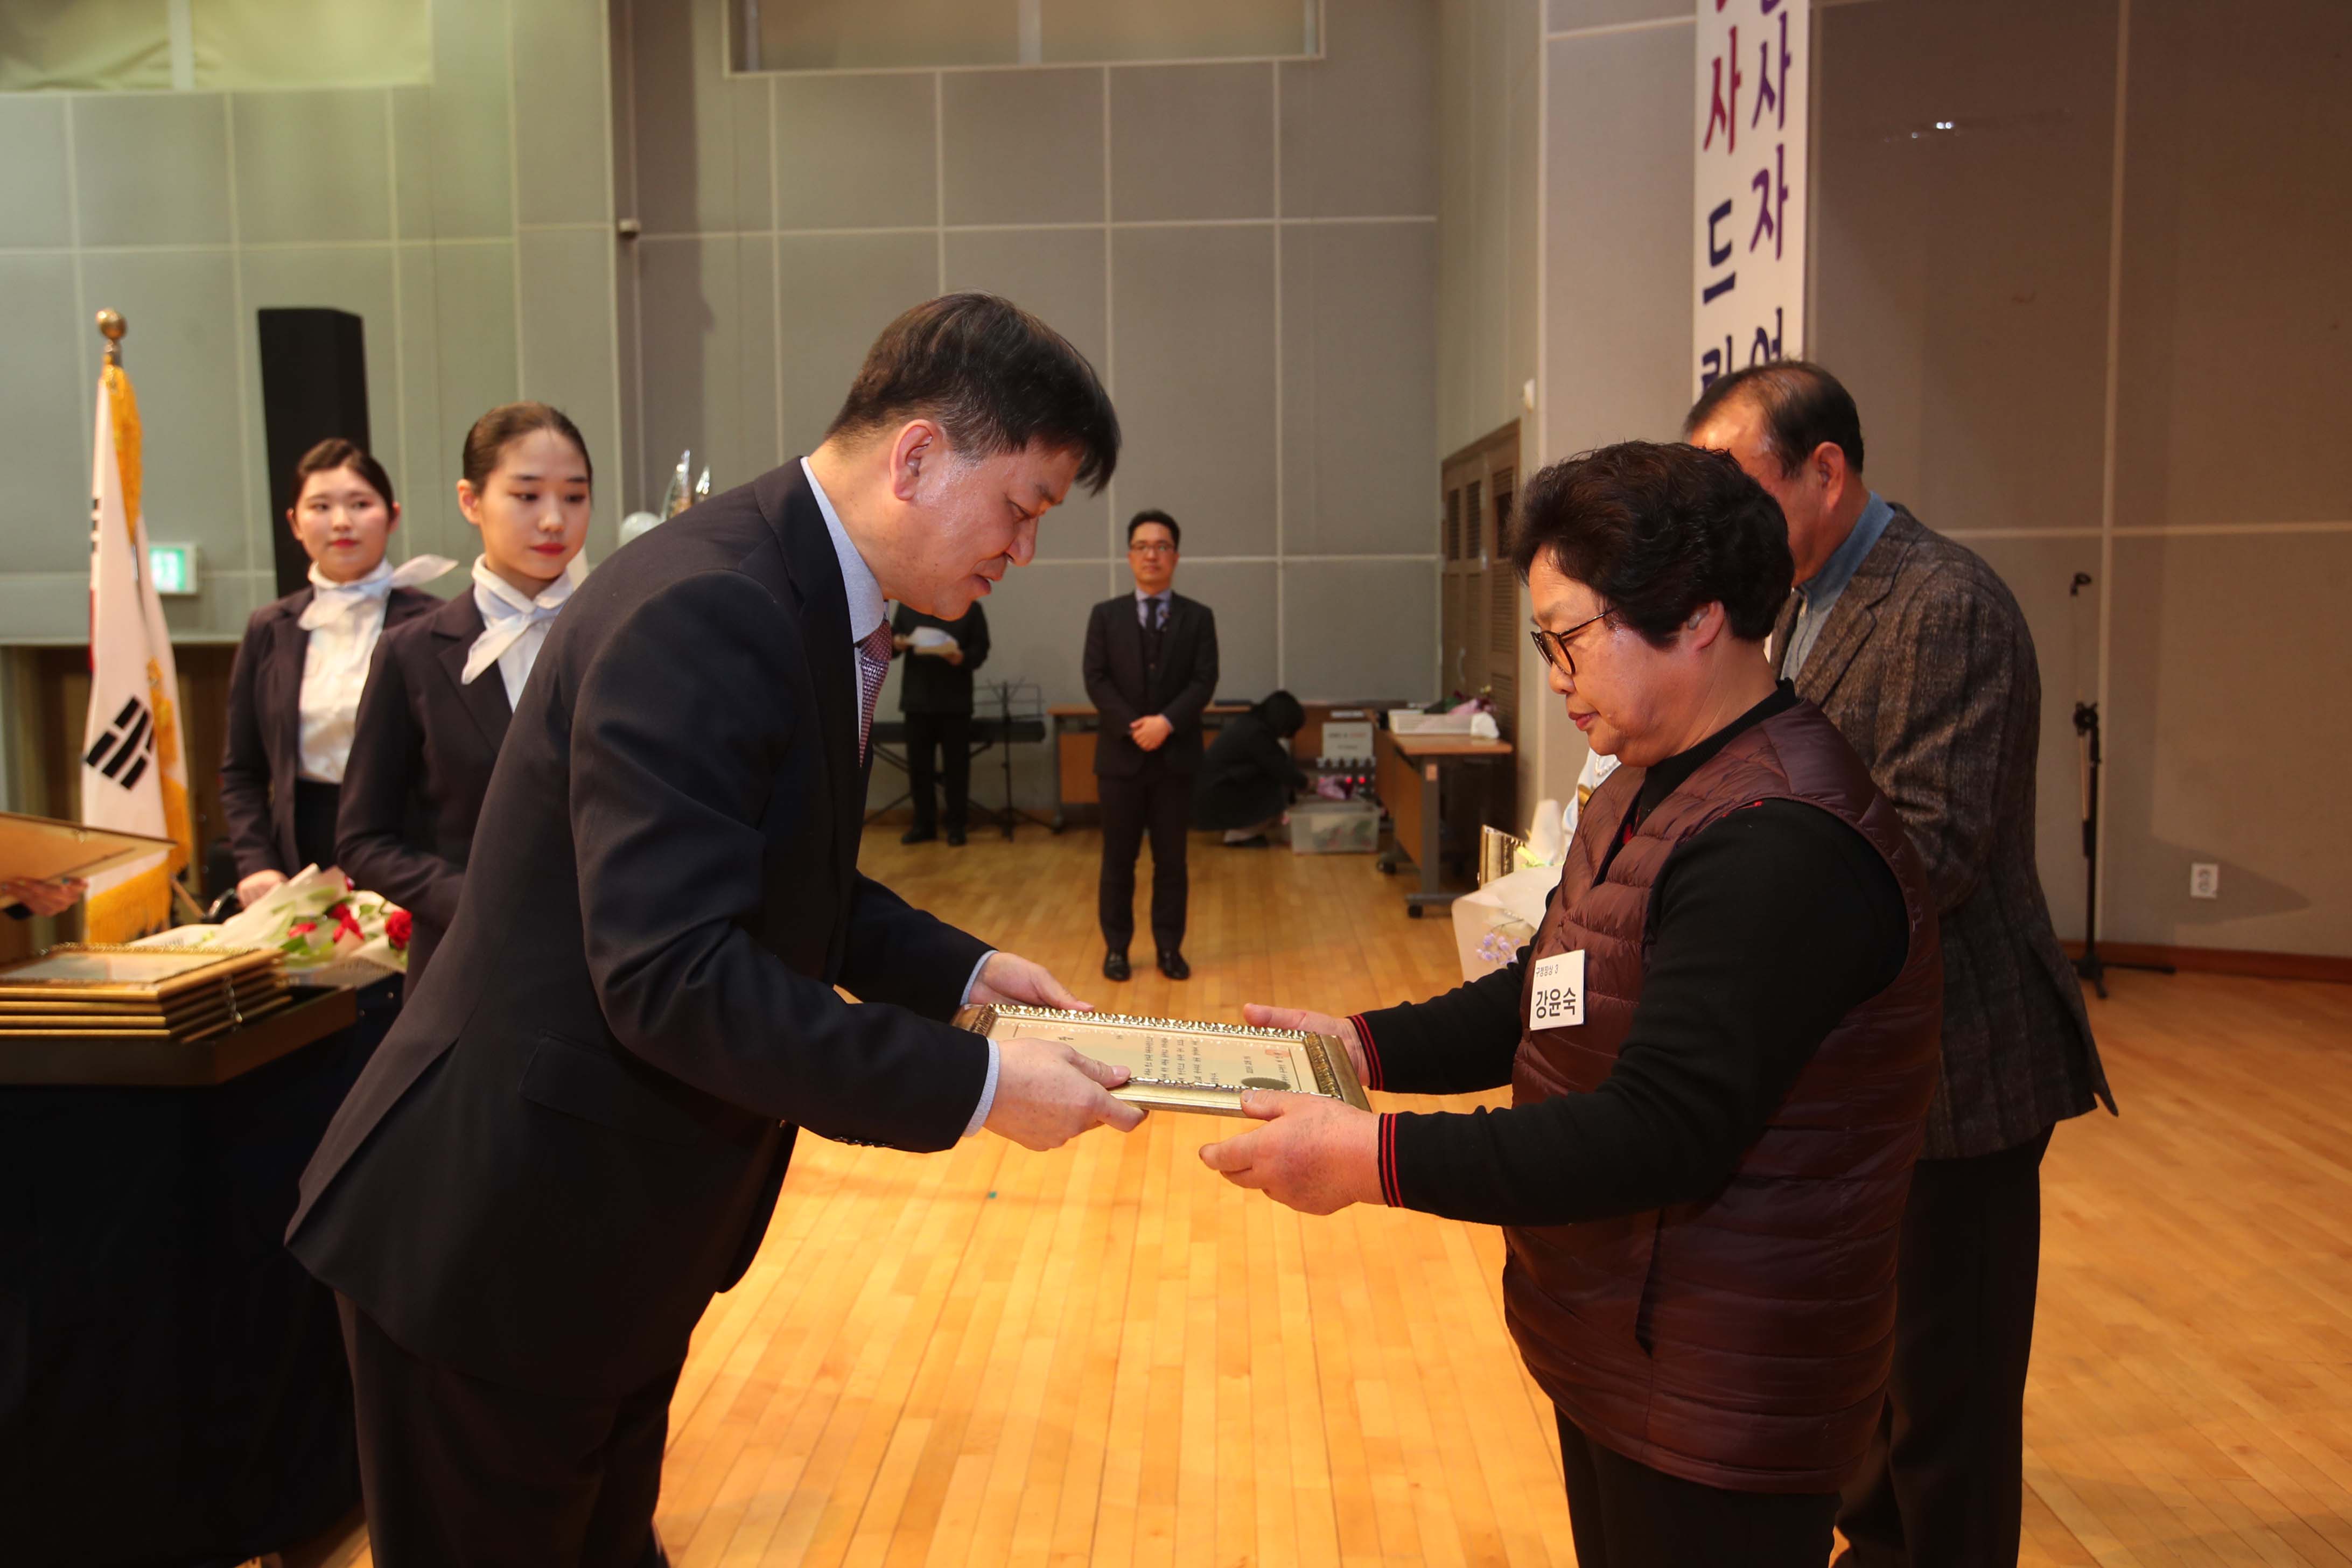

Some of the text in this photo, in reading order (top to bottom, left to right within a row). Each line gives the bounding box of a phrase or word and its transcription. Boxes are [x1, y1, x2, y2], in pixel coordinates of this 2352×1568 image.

[1751, 0, 1791, 262] 사자
[1555, 964, 1559, 974] 3
[1536, 987, 1576, 1019] 강윤숙
